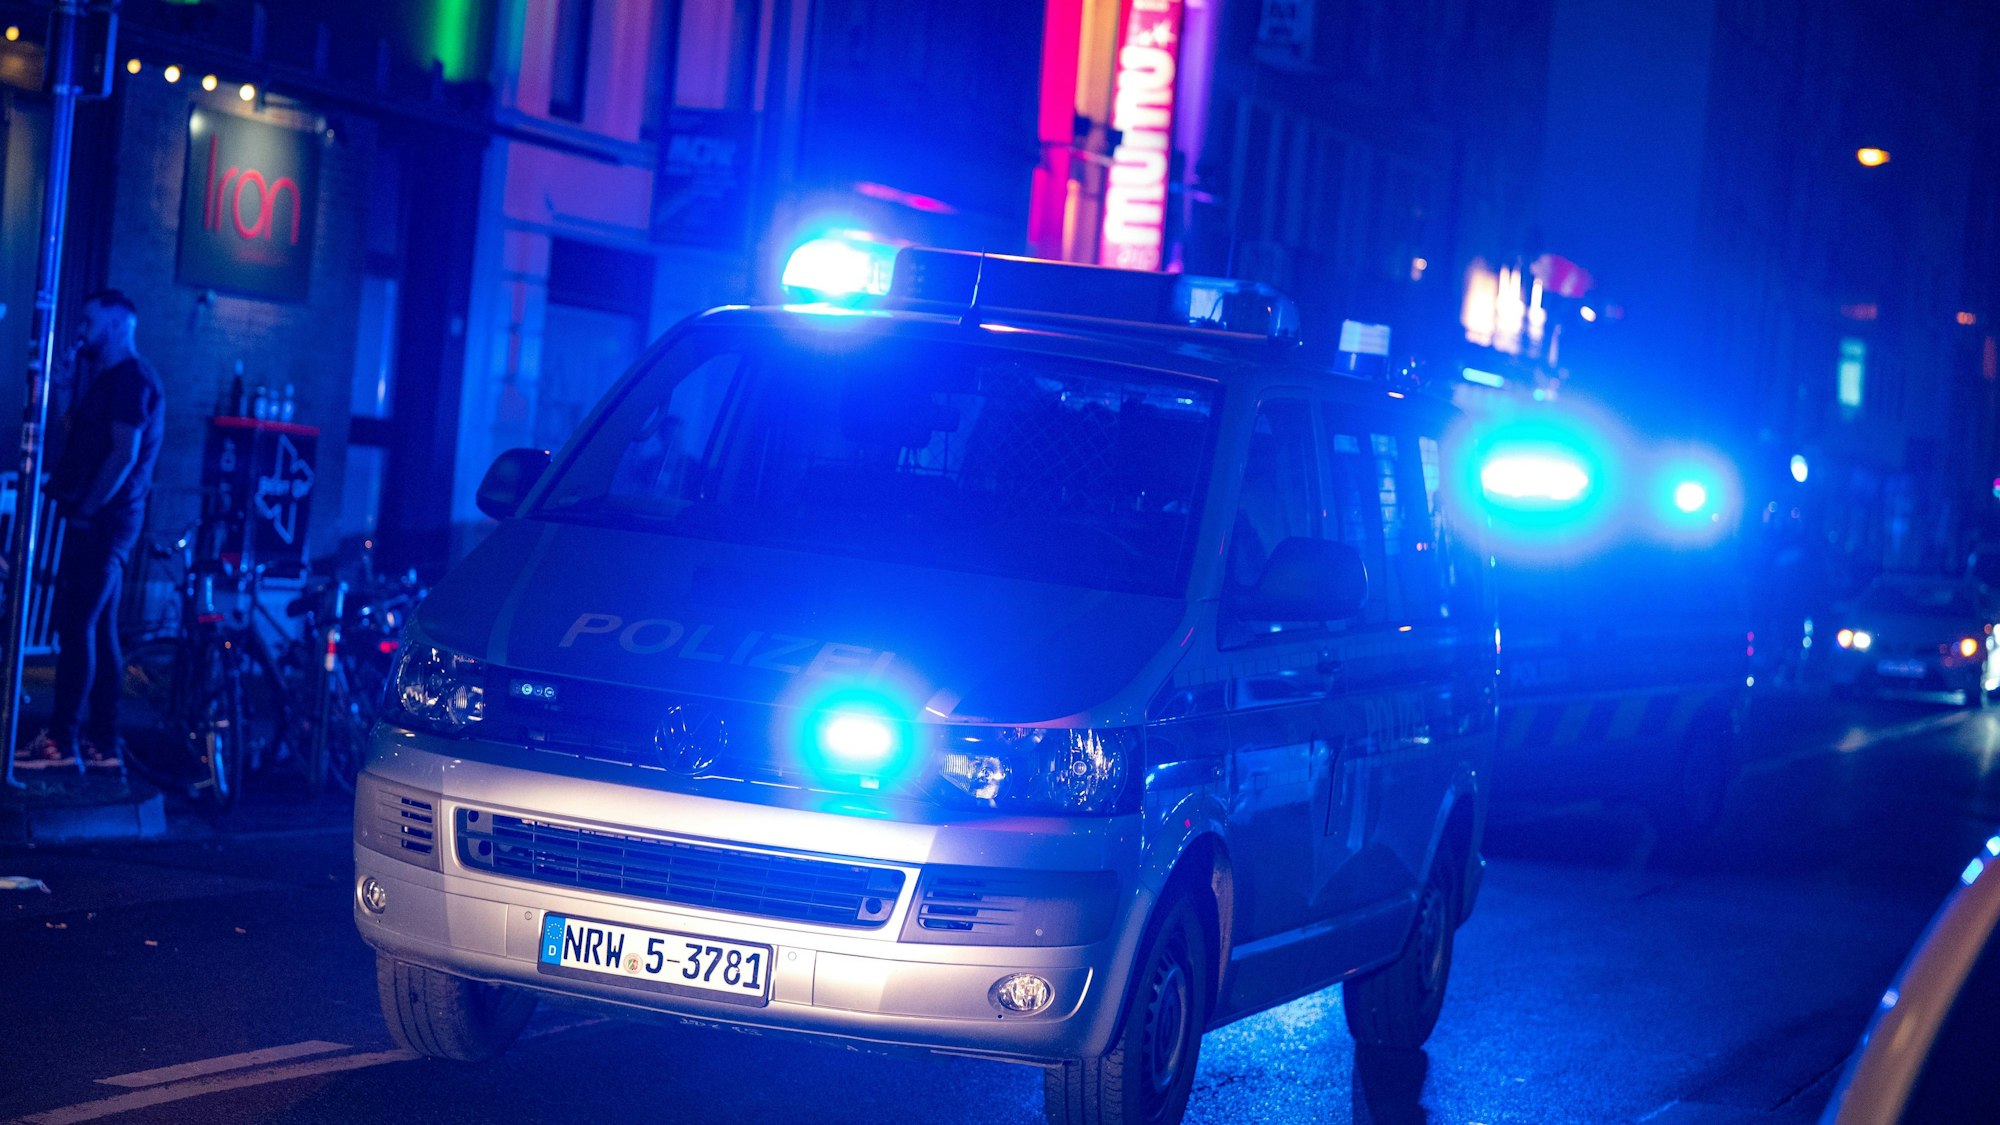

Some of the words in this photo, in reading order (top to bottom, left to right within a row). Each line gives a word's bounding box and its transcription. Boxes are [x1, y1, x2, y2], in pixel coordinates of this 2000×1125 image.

[204, 132, 301, 245] Iron
[558, 612, 896, 684] POLIZEI
[548, 944, 557, 957] D
[563, 925, 625, 969] NRW
[645, 937, 761, 990] 5-3781
